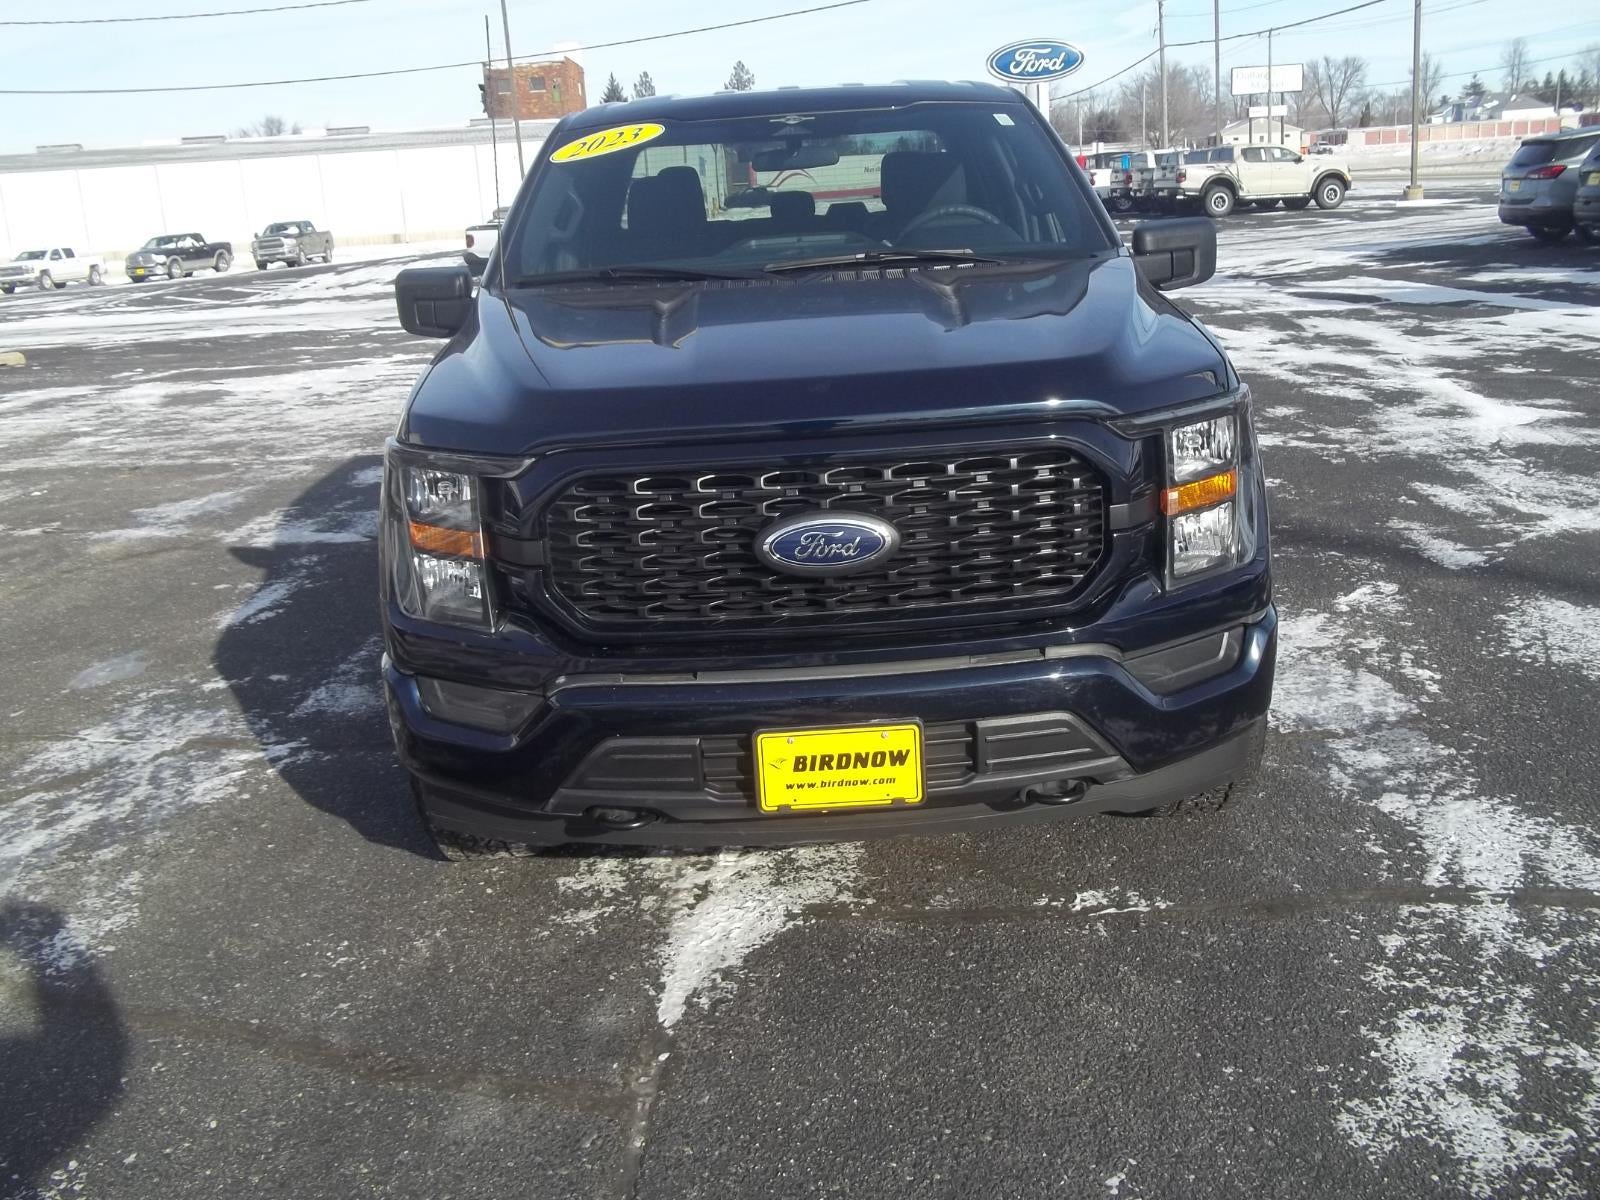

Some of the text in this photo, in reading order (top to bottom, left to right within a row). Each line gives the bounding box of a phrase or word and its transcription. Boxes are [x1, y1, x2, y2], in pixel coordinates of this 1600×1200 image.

[1010, 48, 1066, 74] Ford
[567, 127, 643, 158] 2023
[795, 531, 861, 559] Ford
[792, 748, 911, 773] BIRDNOW
[785, 777, 897, 790] www.birdnow.com
